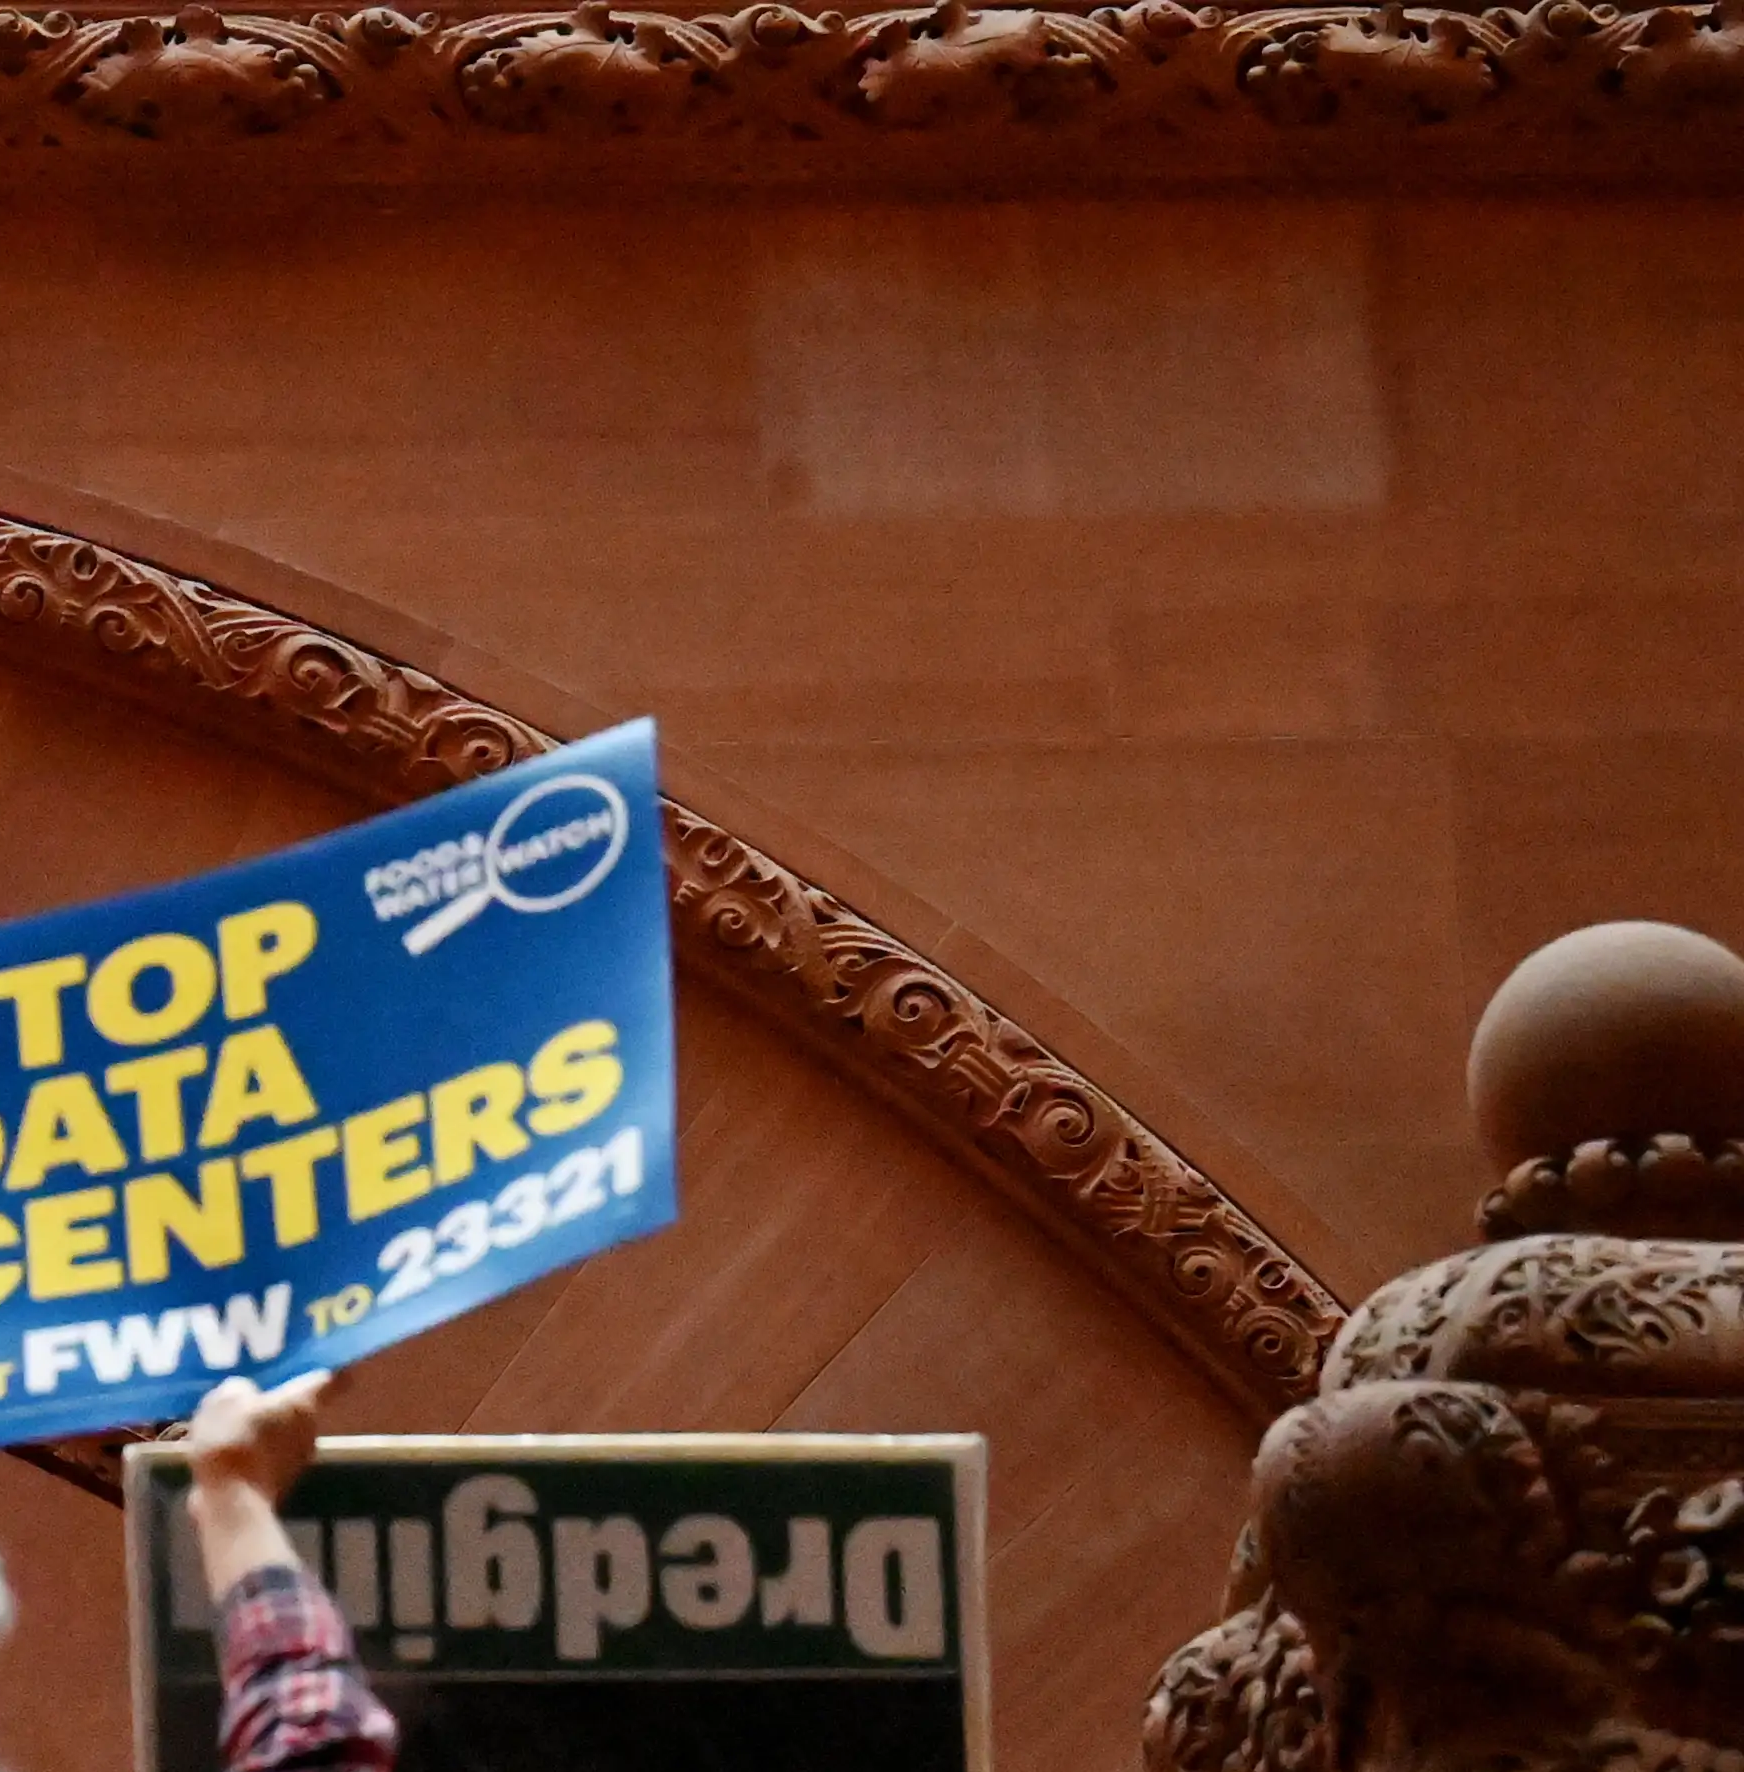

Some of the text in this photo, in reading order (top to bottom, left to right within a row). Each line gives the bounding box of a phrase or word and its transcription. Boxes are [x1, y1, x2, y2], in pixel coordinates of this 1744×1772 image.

[497, 808, 613, 875] WATCH
[21, 1282, 292, 1394] FWW
[306, 1284, 372, 1337] TO
[376, 1125, 645, 1308] 23321
